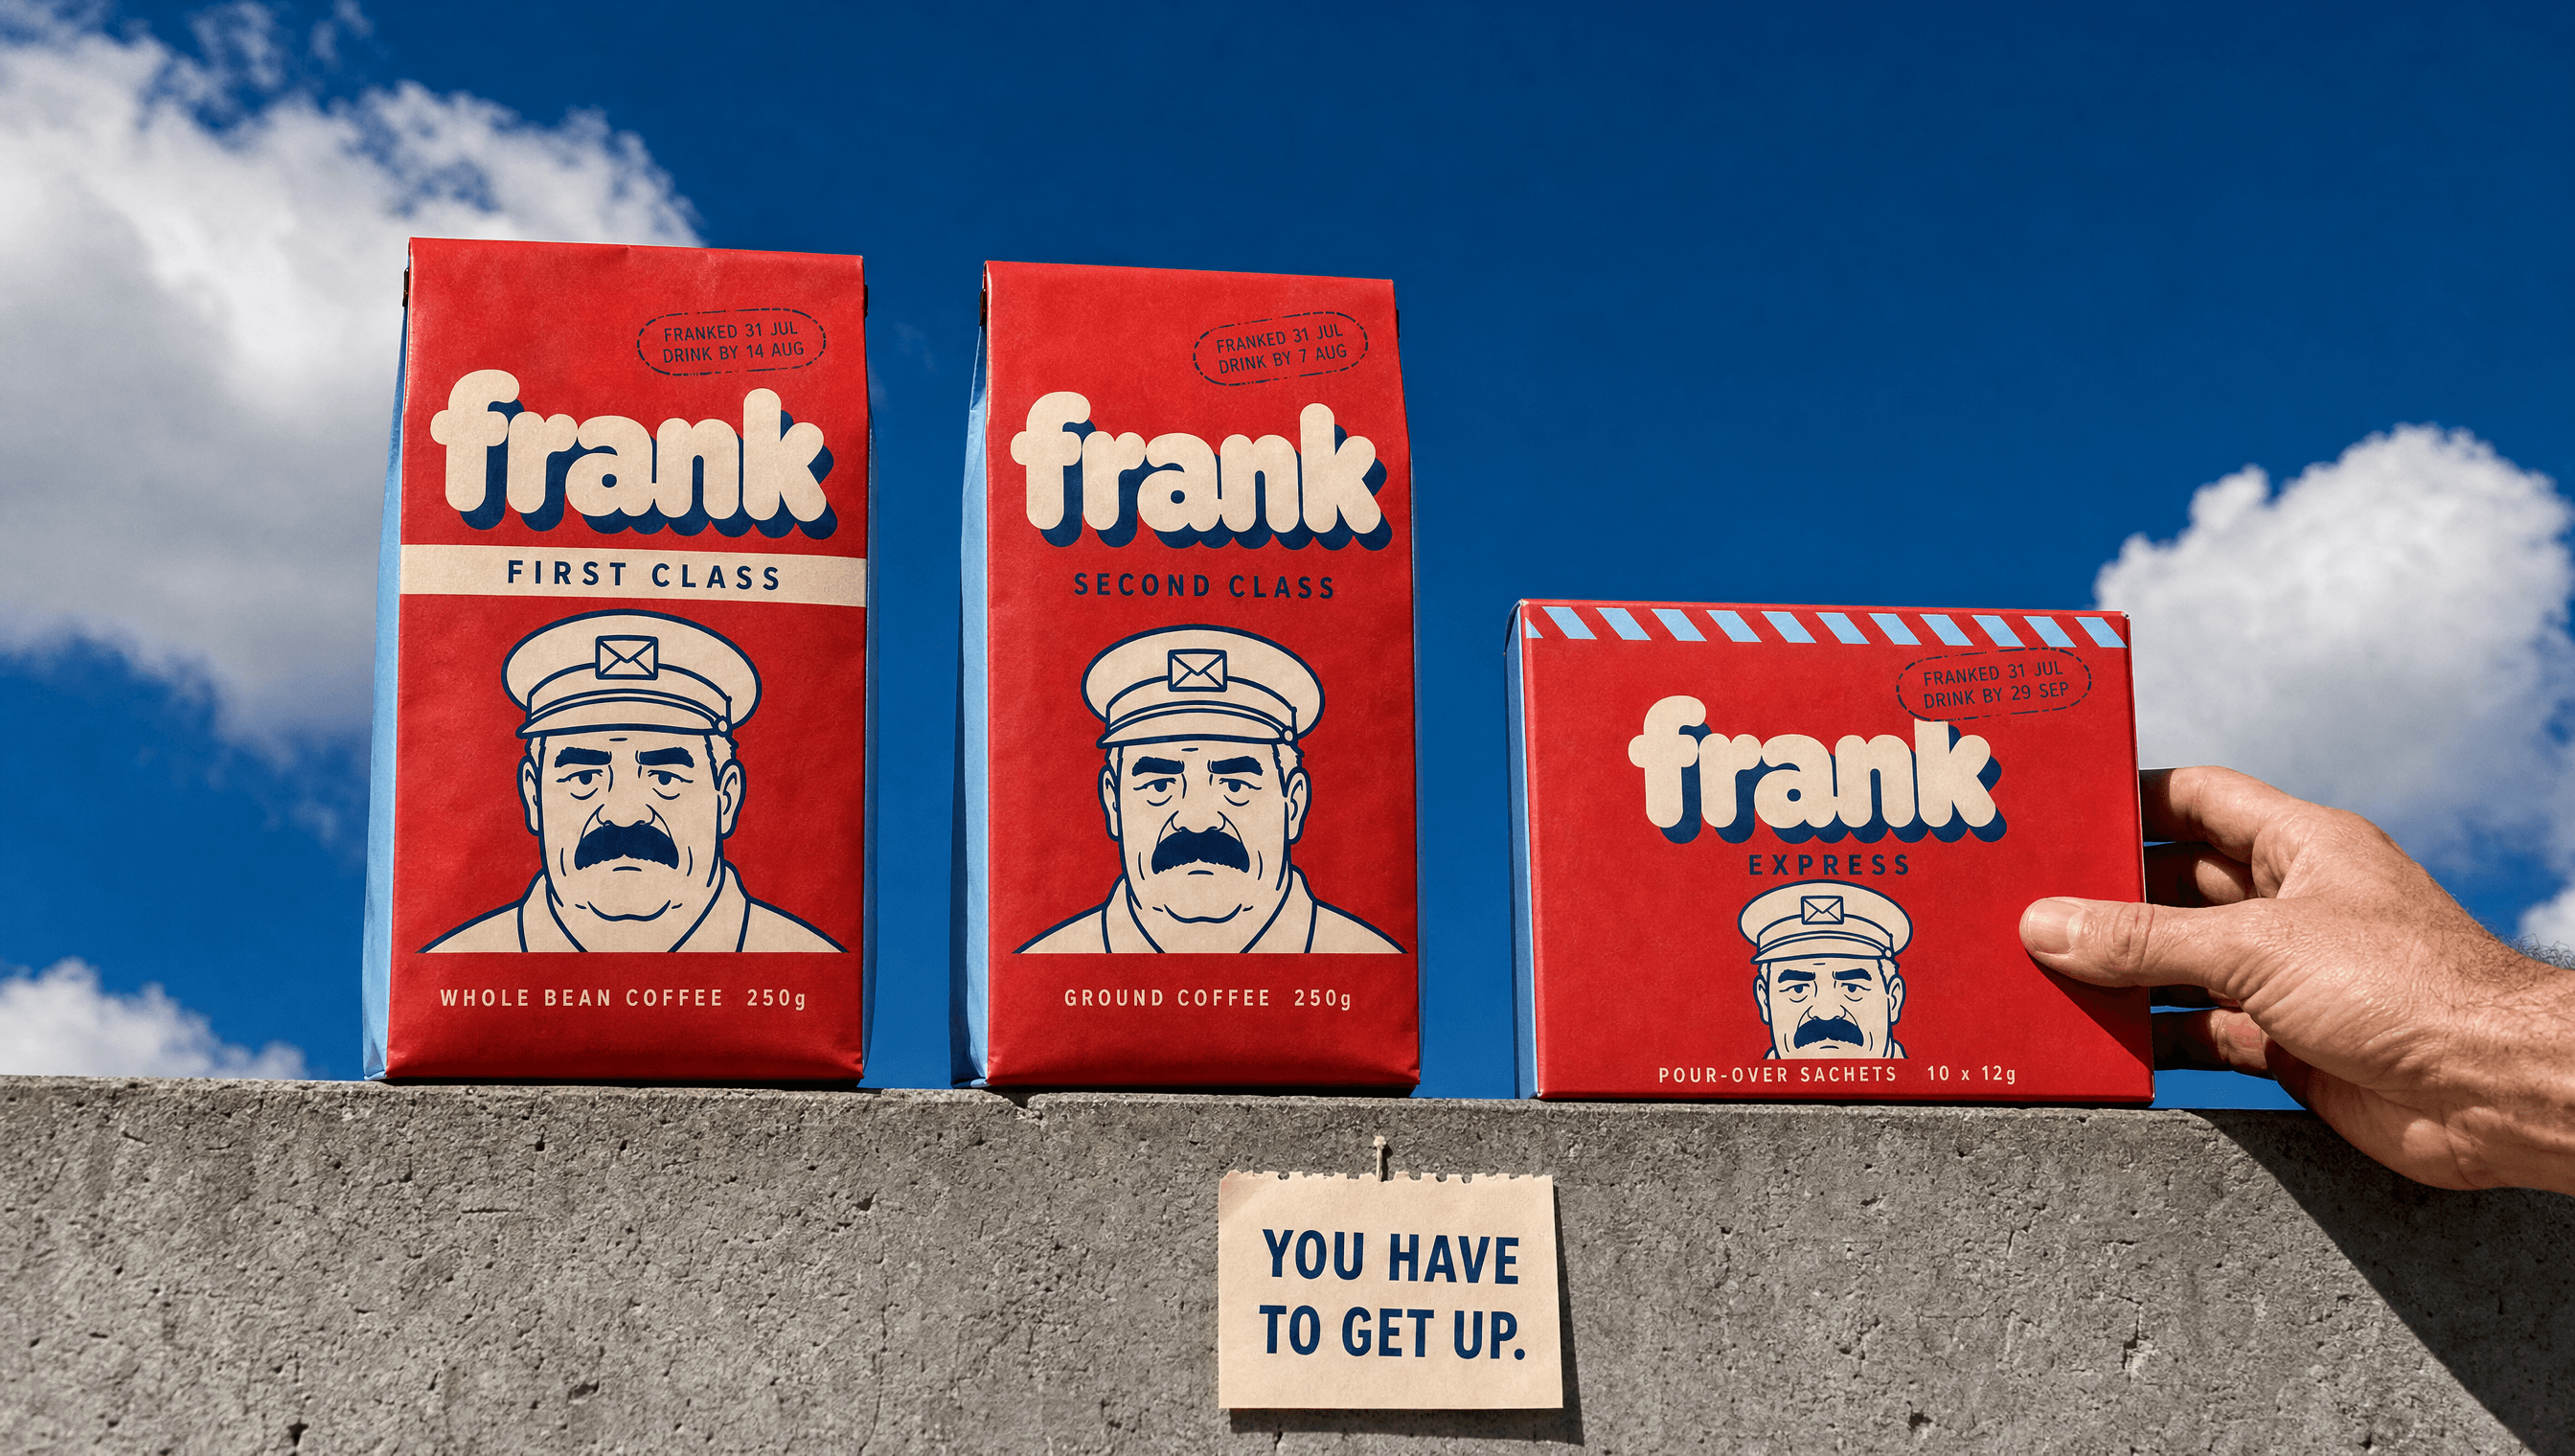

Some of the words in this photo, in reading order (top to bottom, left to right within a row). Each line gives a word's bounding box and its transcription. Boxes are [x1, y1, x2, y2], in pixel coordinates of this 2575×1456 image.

[664, 324, 738, 343] FRANKED
[744, 322, 763, 338] 31
[770, 321, 799, 336] JUL
[1216, 330, 1287, 354] FRANKED
[1292, 327, 1310, 343] 31
[1316, 323, 1344, 340] JUL
[662, 346, 713, 364] DRINK
[718, 345, 739, 360] BY
[745, 343, 764, 359] 14
[771, 341, 805, 357] AUG
[1219, 354, 1267, 375] DRINK
[1272, 351, 1291, 367] BY
[1298, 348, 1307, 363] 7
[1315, 343, 1348, 361] AUG
[429, 369, 832, 531] frank
[1010, 391, 1387, 543] frank
[508, 559, 627, 586] FIRST
[651, 562, 779, 591] CLASS
[1073, 572, 1210, 598] SECOND
[1228, 574, 1334, 600] CLASS
[1923, 666, 2000, 687] FRANKED
[2007, 663, 2025, 679] 31
[2034, 660, 2063, 677] JUL
[1923, 689, 1976, 710] DRINK
[1982, 686, 2003, 704] BY
[2010, 684, 2031, 701] 29
[2039, 681, 2069, 698] SEP
[1628, 694, 2002, 837] frank
[1748, 853, 1909, 876] EXPRESS
[440, 989, 529, 1007] WHOLE
[544, 989, 610, 1007] BEAN
[626, 989, 721, 1007] COFFEE
[747, 989, 805, 1012] 250g
[1064, 989, 1163, 1007] GROUND
[1177, 989, 1269, 1007] COFFEE
[1294, 989, 1351, 1012] 250g
[1658, 1066, 1788, 1083] POUR-OVER
[1800, 1066, 1896, 1082] SACHETS
[1927, 1065, 1949, 1081] 10
[1961, 1069, 1971, 1081] x
[1981, 1064, 2016, 1085] 12g
[1262, 1228, 1364, 1281] YOU
[1388, 1233, 1519, 1285] HAVE
[1259, 1304, 1321, 1356] TO
[1341, 1306, 1435, 1358] GET
[1453, 1309, 1526, 1361] UP.
